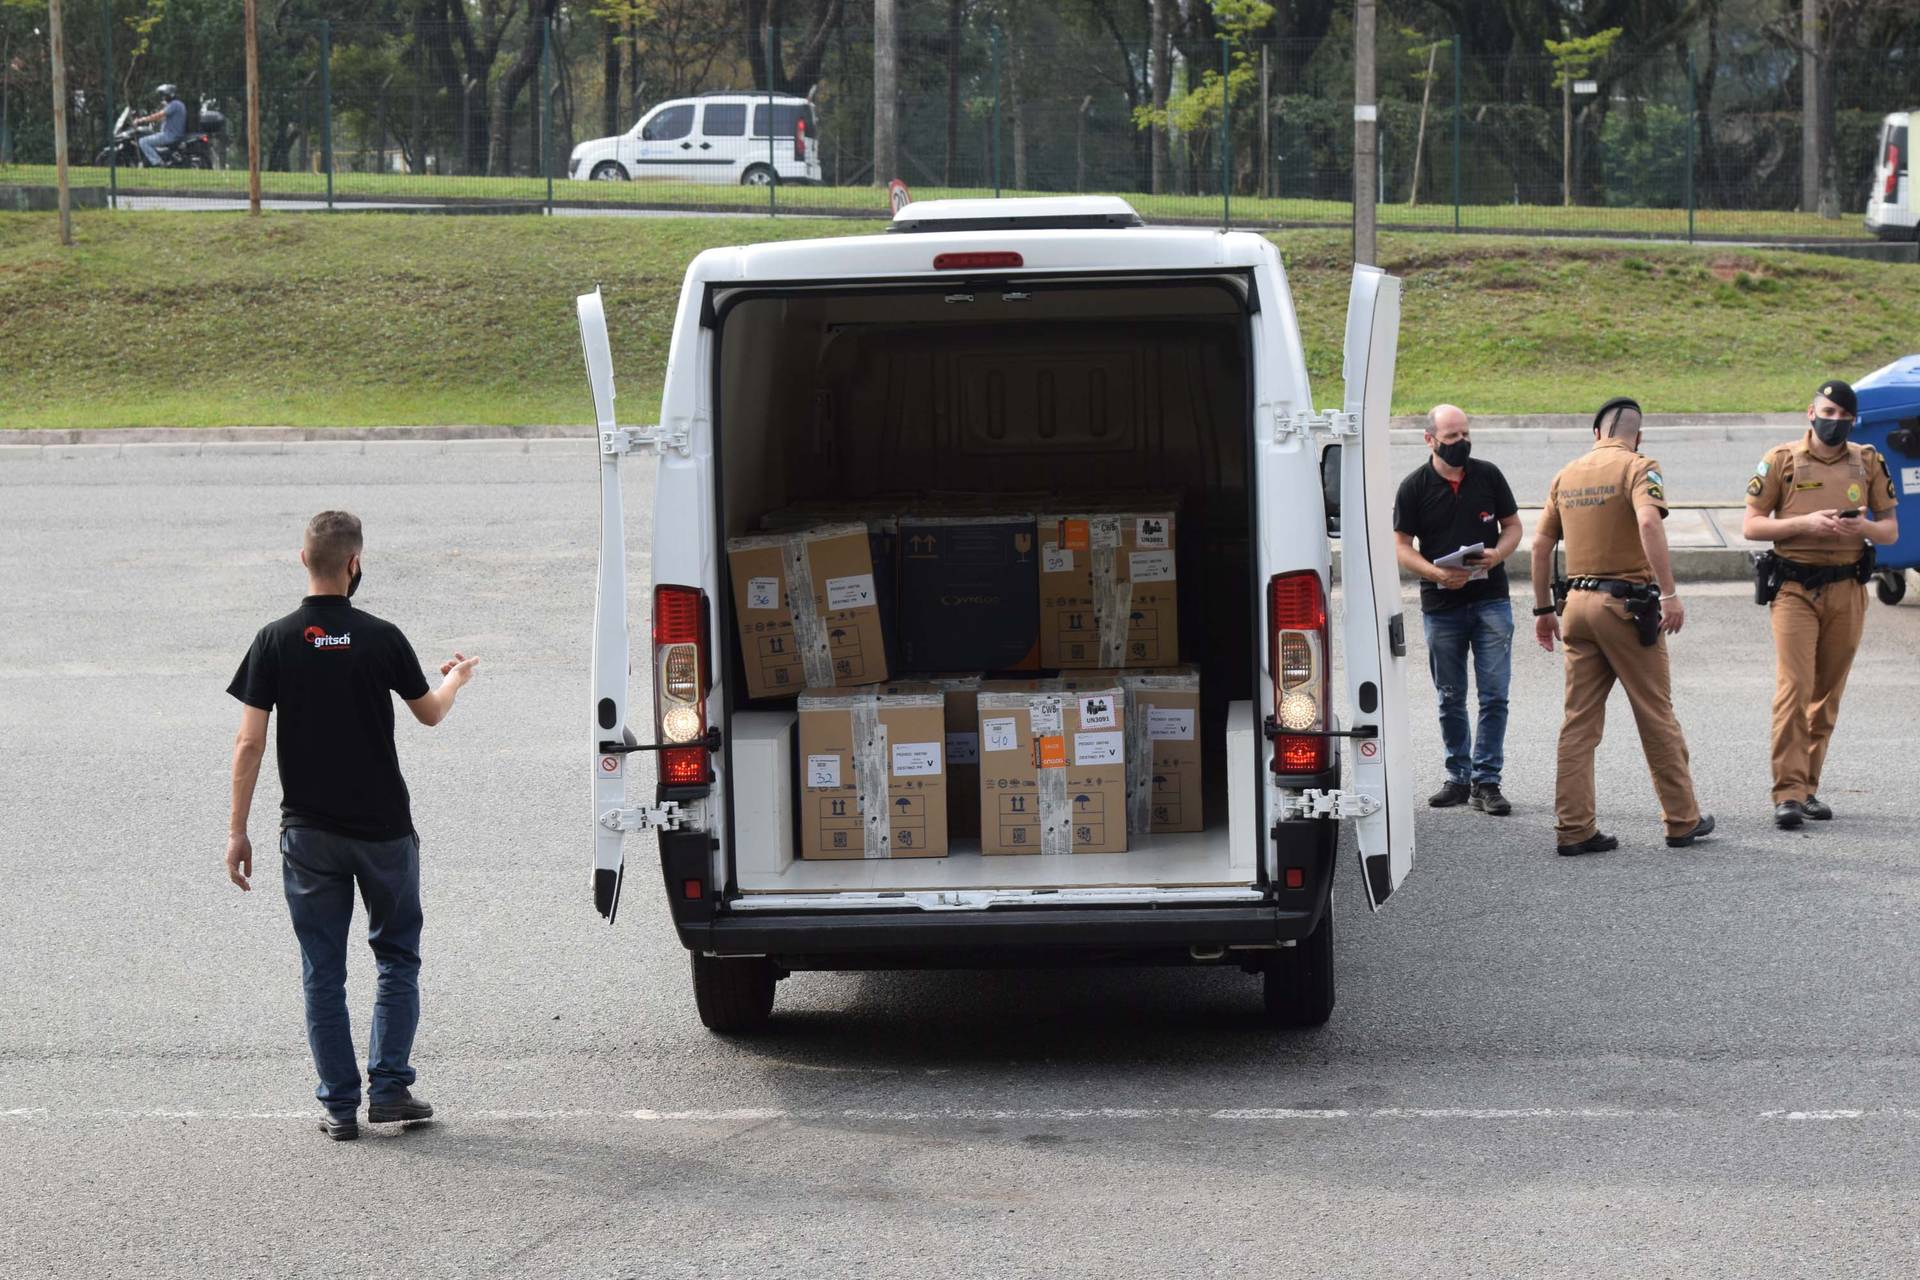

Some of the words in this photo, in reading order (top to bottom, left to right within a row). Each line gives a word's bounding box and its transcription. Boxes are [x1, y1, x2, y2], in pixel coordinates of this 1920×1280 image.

[1584, 486, 1616, 495] MILITAR
[753, 594, 769, 606] 36
[314, 633, 351, 648] gritsch
[1041, 704, 1057, 714] CWB
[991, 735, 1008, 748] 40
[815, 772, 833, 784] 32
